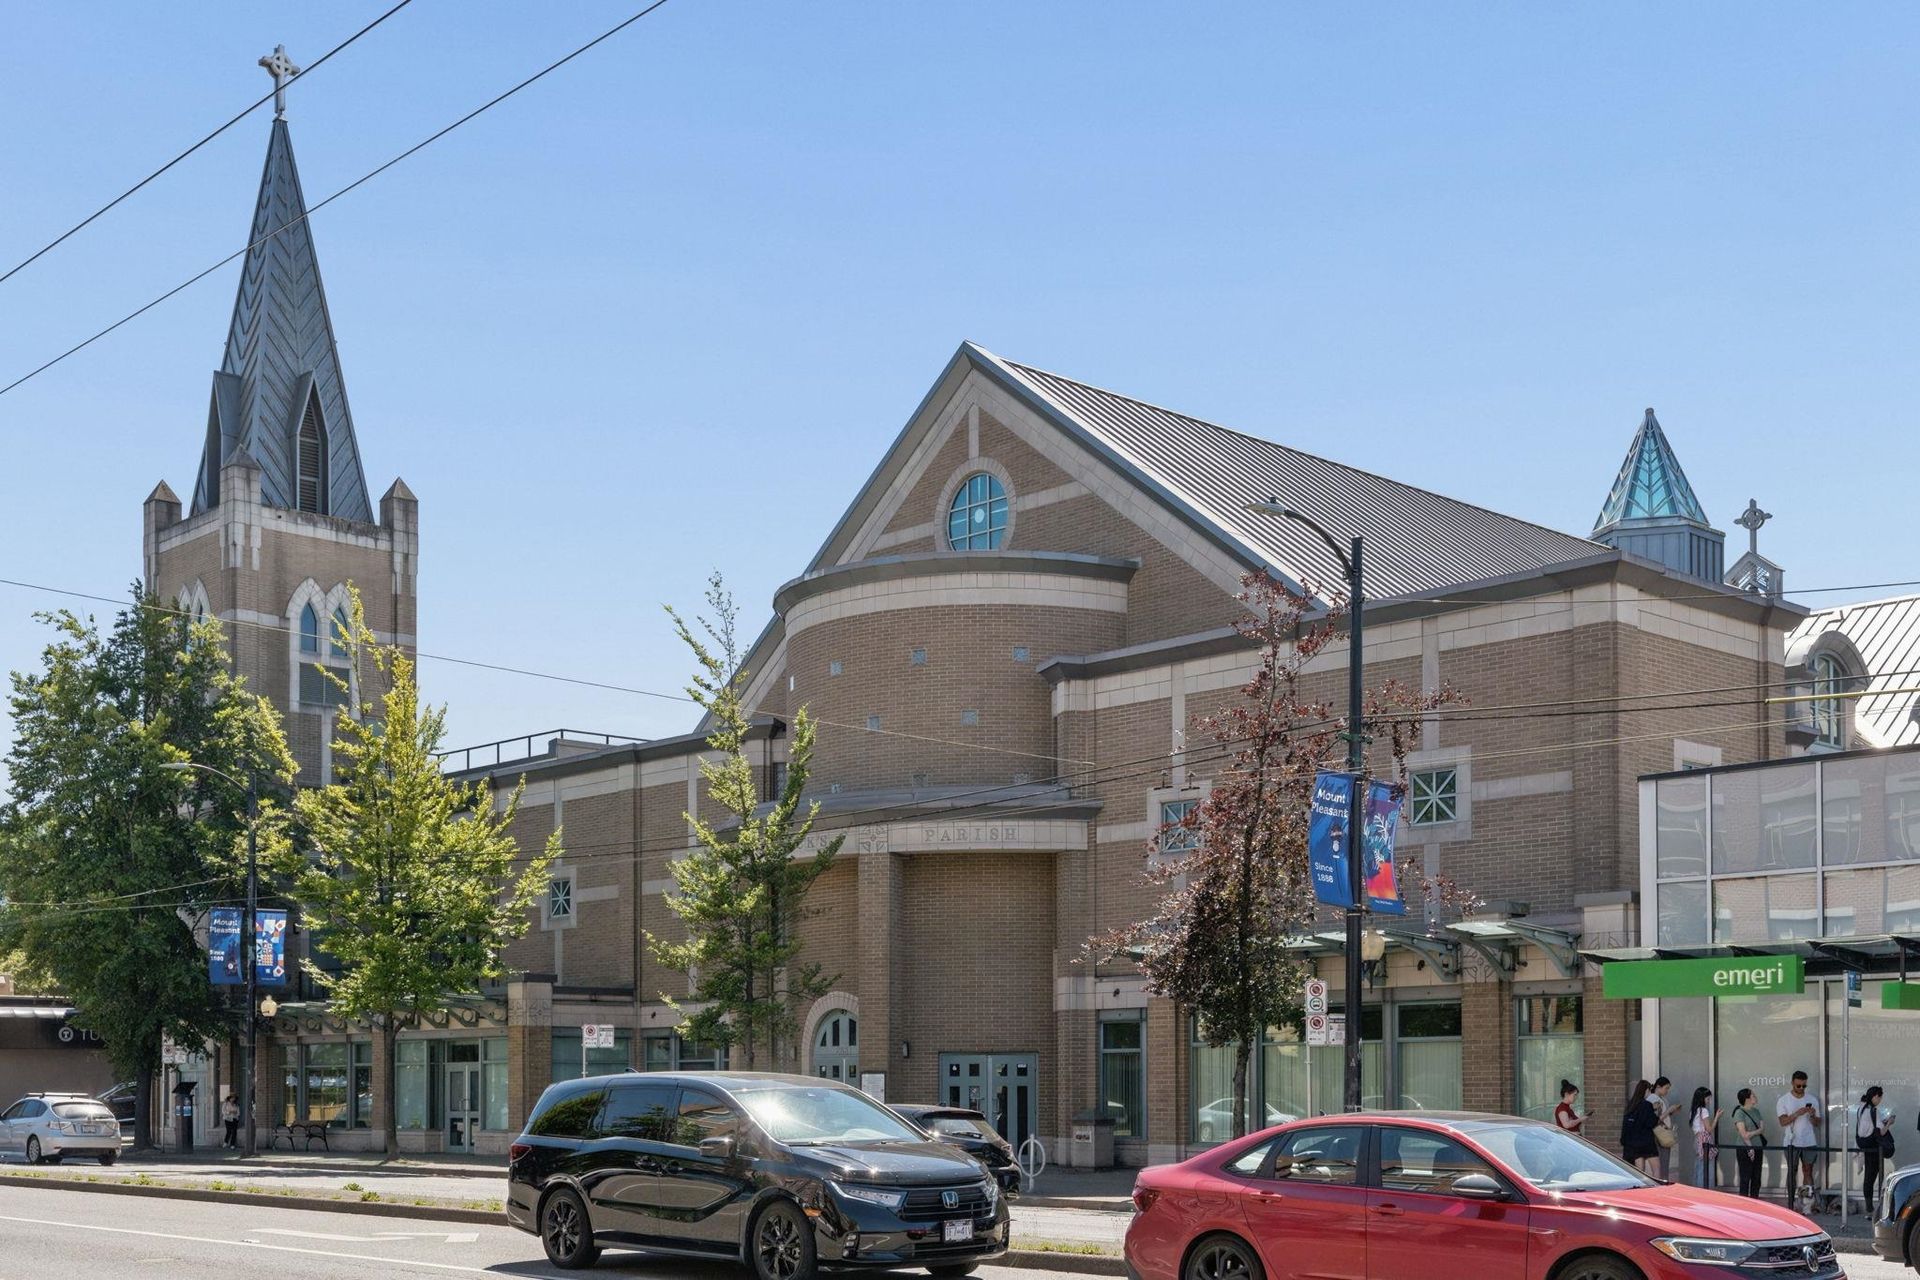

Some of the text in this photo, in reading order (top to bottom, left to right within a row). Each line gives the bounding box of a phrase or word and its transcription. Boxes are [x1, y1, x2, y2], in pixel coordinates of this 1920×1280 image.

[1316, 788, 1346, 804] Mount
[1311, 802, 1349, 818] Pleasant
[924, 827, 1018, 843] PARISH
[1314, 862, 1334, 873] Since
[209, 926, 241, 934] Pleasant
[1713, 962, 1784, 989] emeri
[1748, 1074, 1786, 1087] emeri
